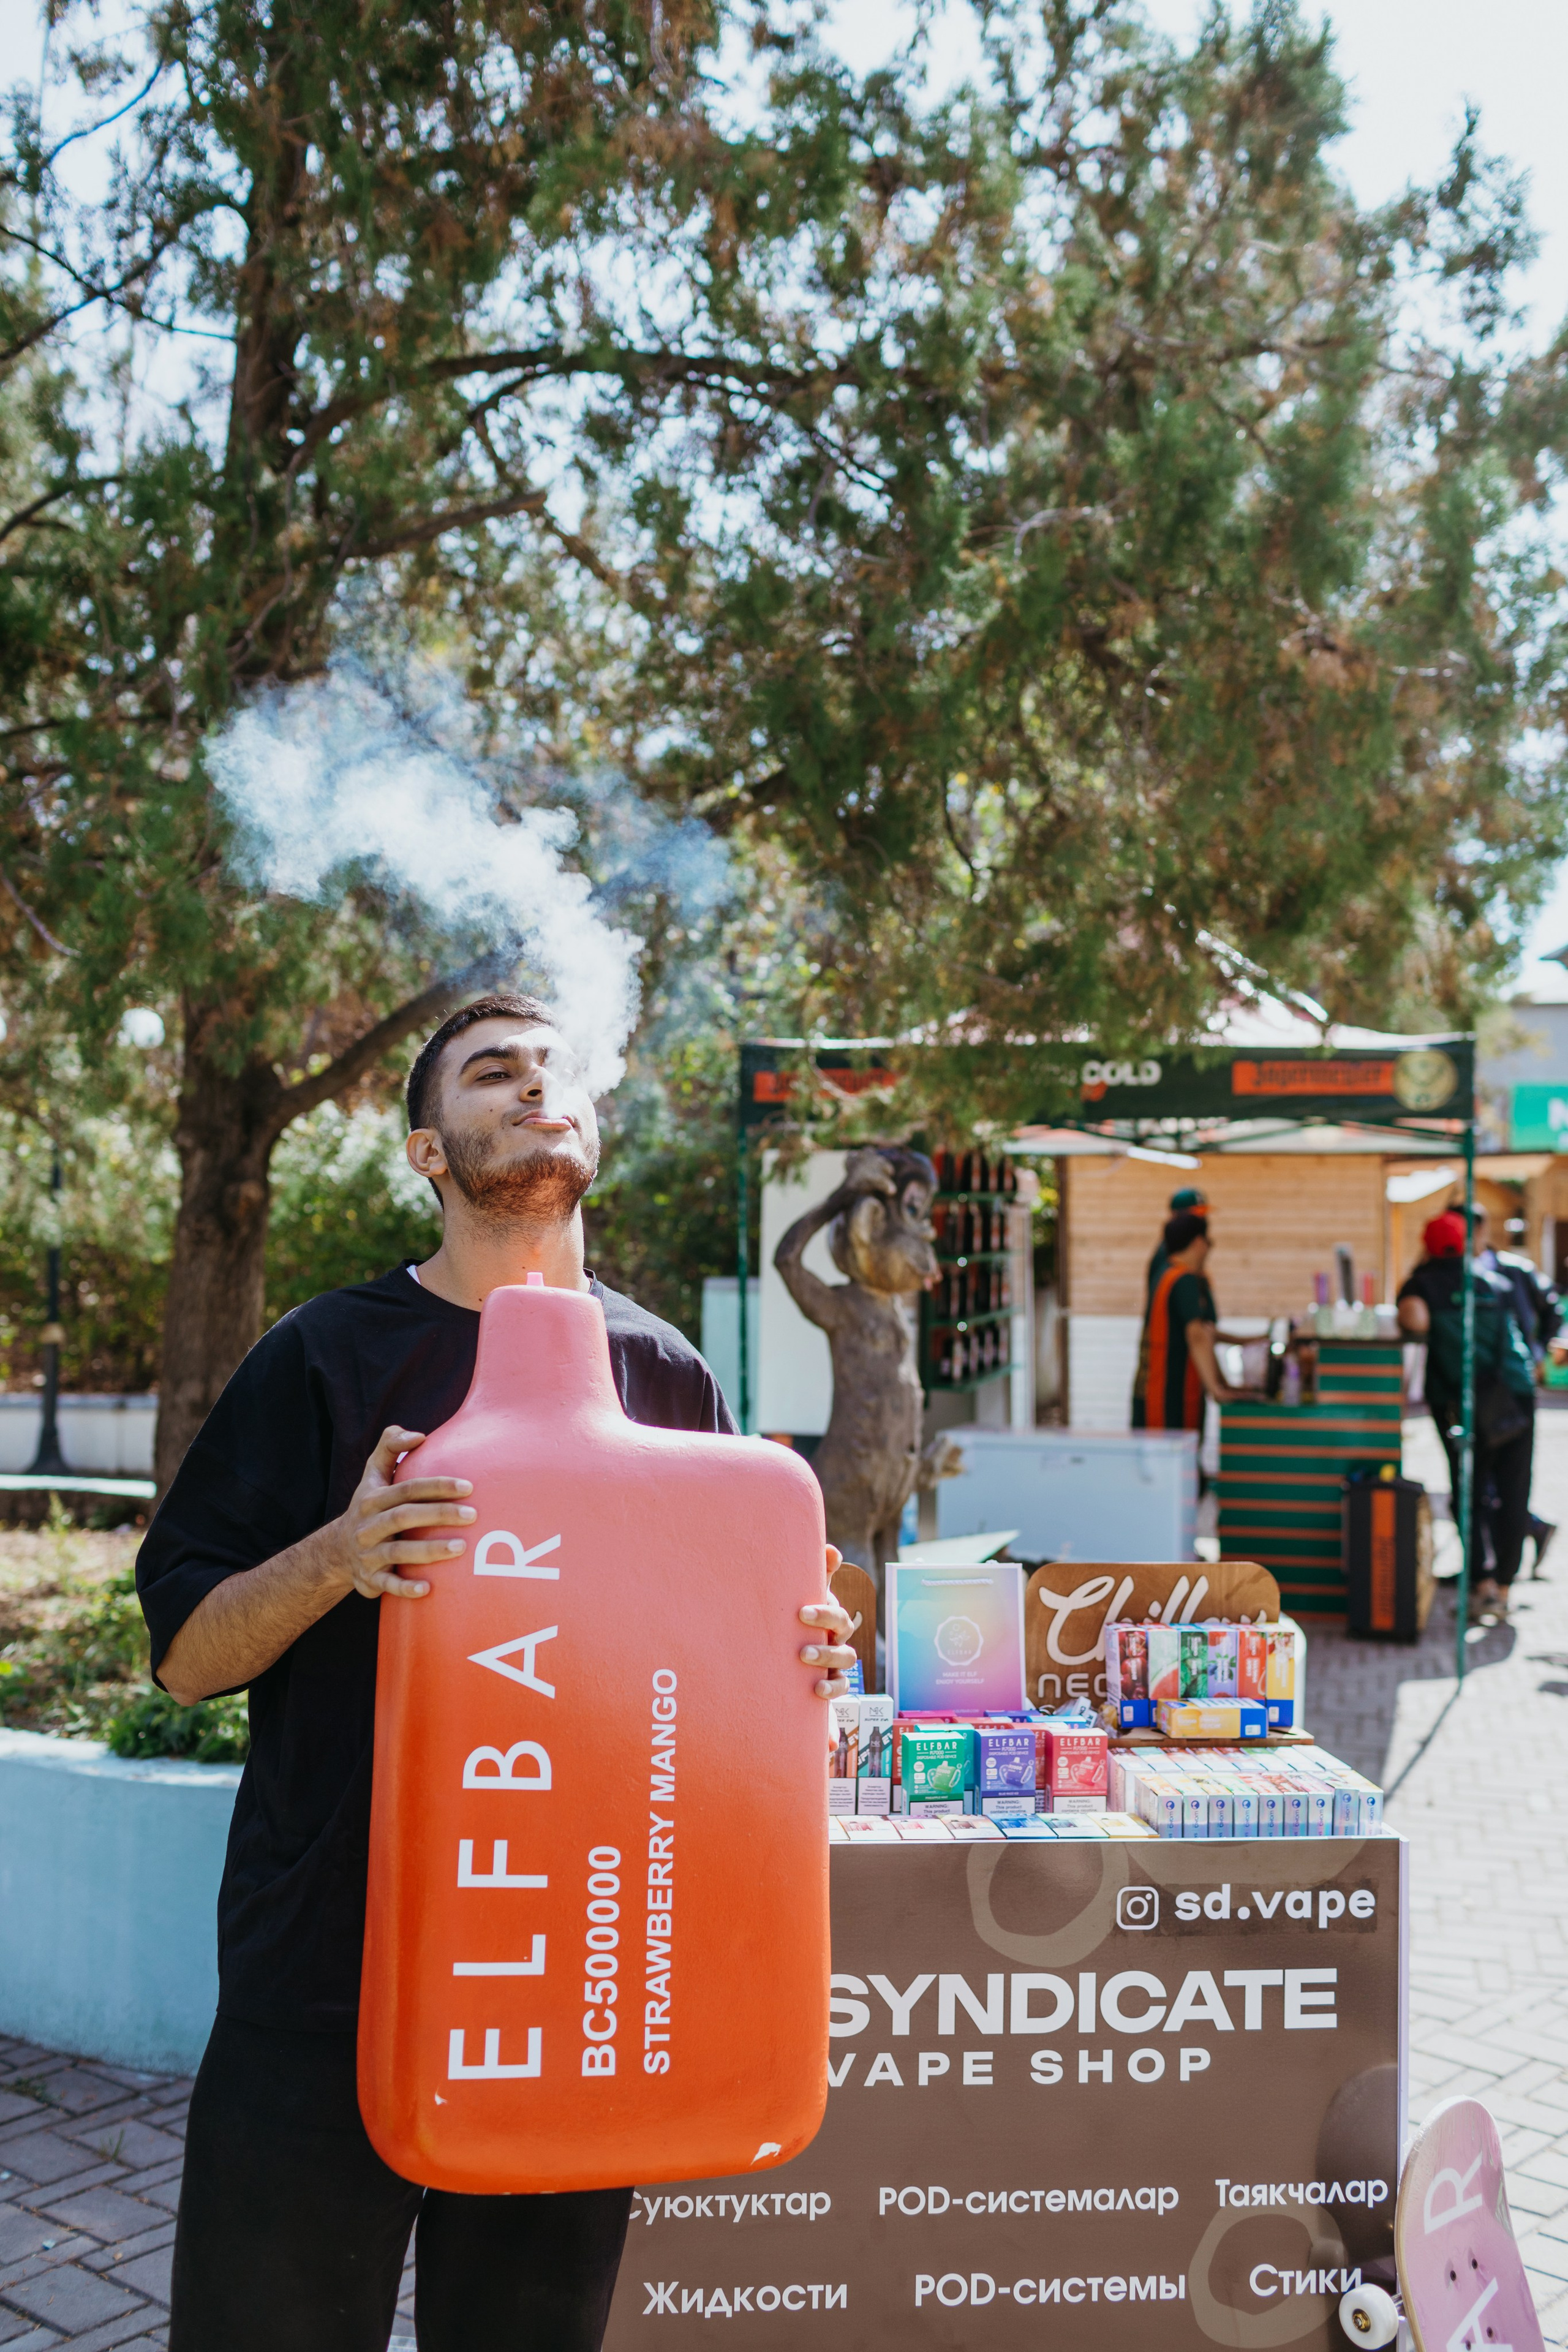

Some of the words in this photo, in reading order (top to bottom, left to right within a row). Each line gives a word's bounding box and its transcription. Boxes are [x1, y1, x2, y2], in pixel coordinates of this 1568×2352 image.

[1081, 1060, 1163, 1086] COLD
[650, 1668, 677, 1802] MANGO
[916, 1741, 957, 1751] ELFBAR
[988, 1738, 1029, 1747] ELFBAR
[1060, 1738, 1101, 1746] ELFBAR
[448, 1529, 562, 2081] ELFBAR
[1175, 1883, 1376, 1929] sd.vape
[581, 1845, 621, 2077] BC500000
[644, 1810, 674, 2075] STRAWBERRY
[829, 1968, 1338, 2038] SYNDICATE
[827, 2051, 993, 2087] VAPE
[1031, 2048, 1212, 2085] SHOP
[1215, 2179, 1389, 2209] Таякчалар
[1250, 2264, 1362, 2297] Стики
[643, 2281, 848, 2319] Жидкости
